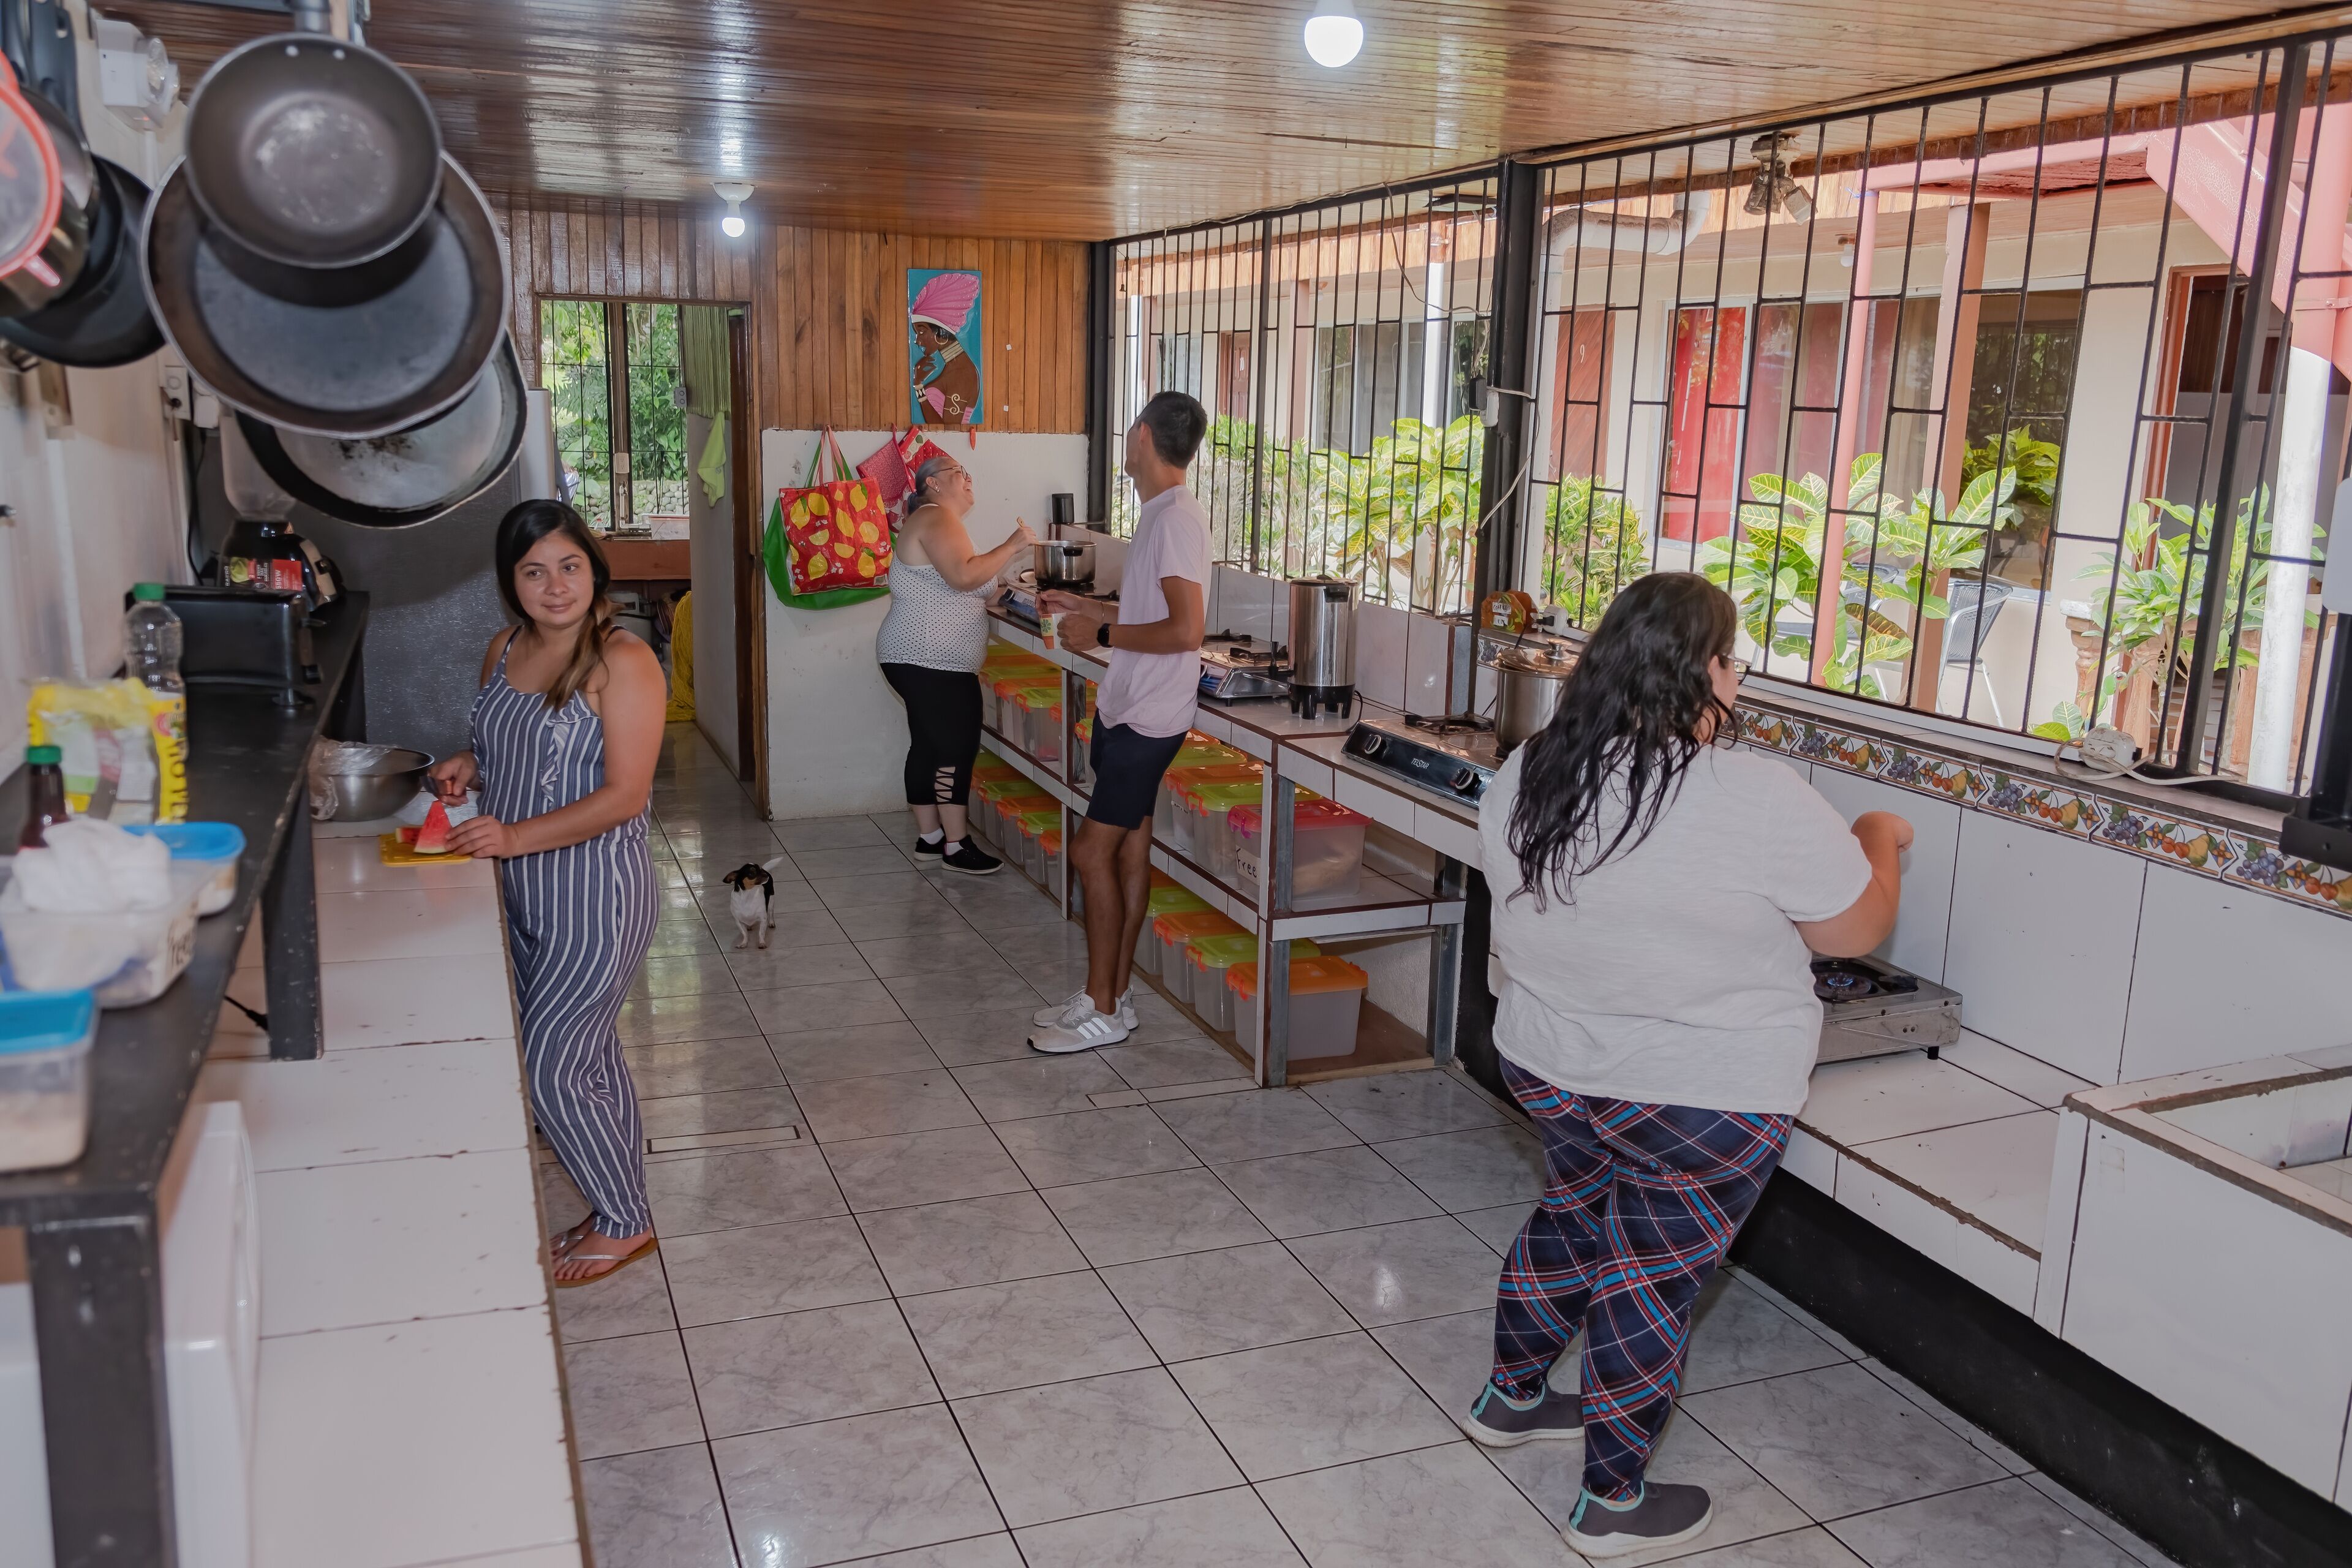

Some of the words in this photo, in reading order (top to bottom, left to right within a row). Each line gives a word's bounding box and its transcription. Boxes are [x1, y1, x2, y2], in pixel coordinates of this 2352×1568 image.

[1580, 344, 1585, 363] 9
[1240, 356, 1245, 371] 10
[1411, 758, 1430, 769] TELSTAR
